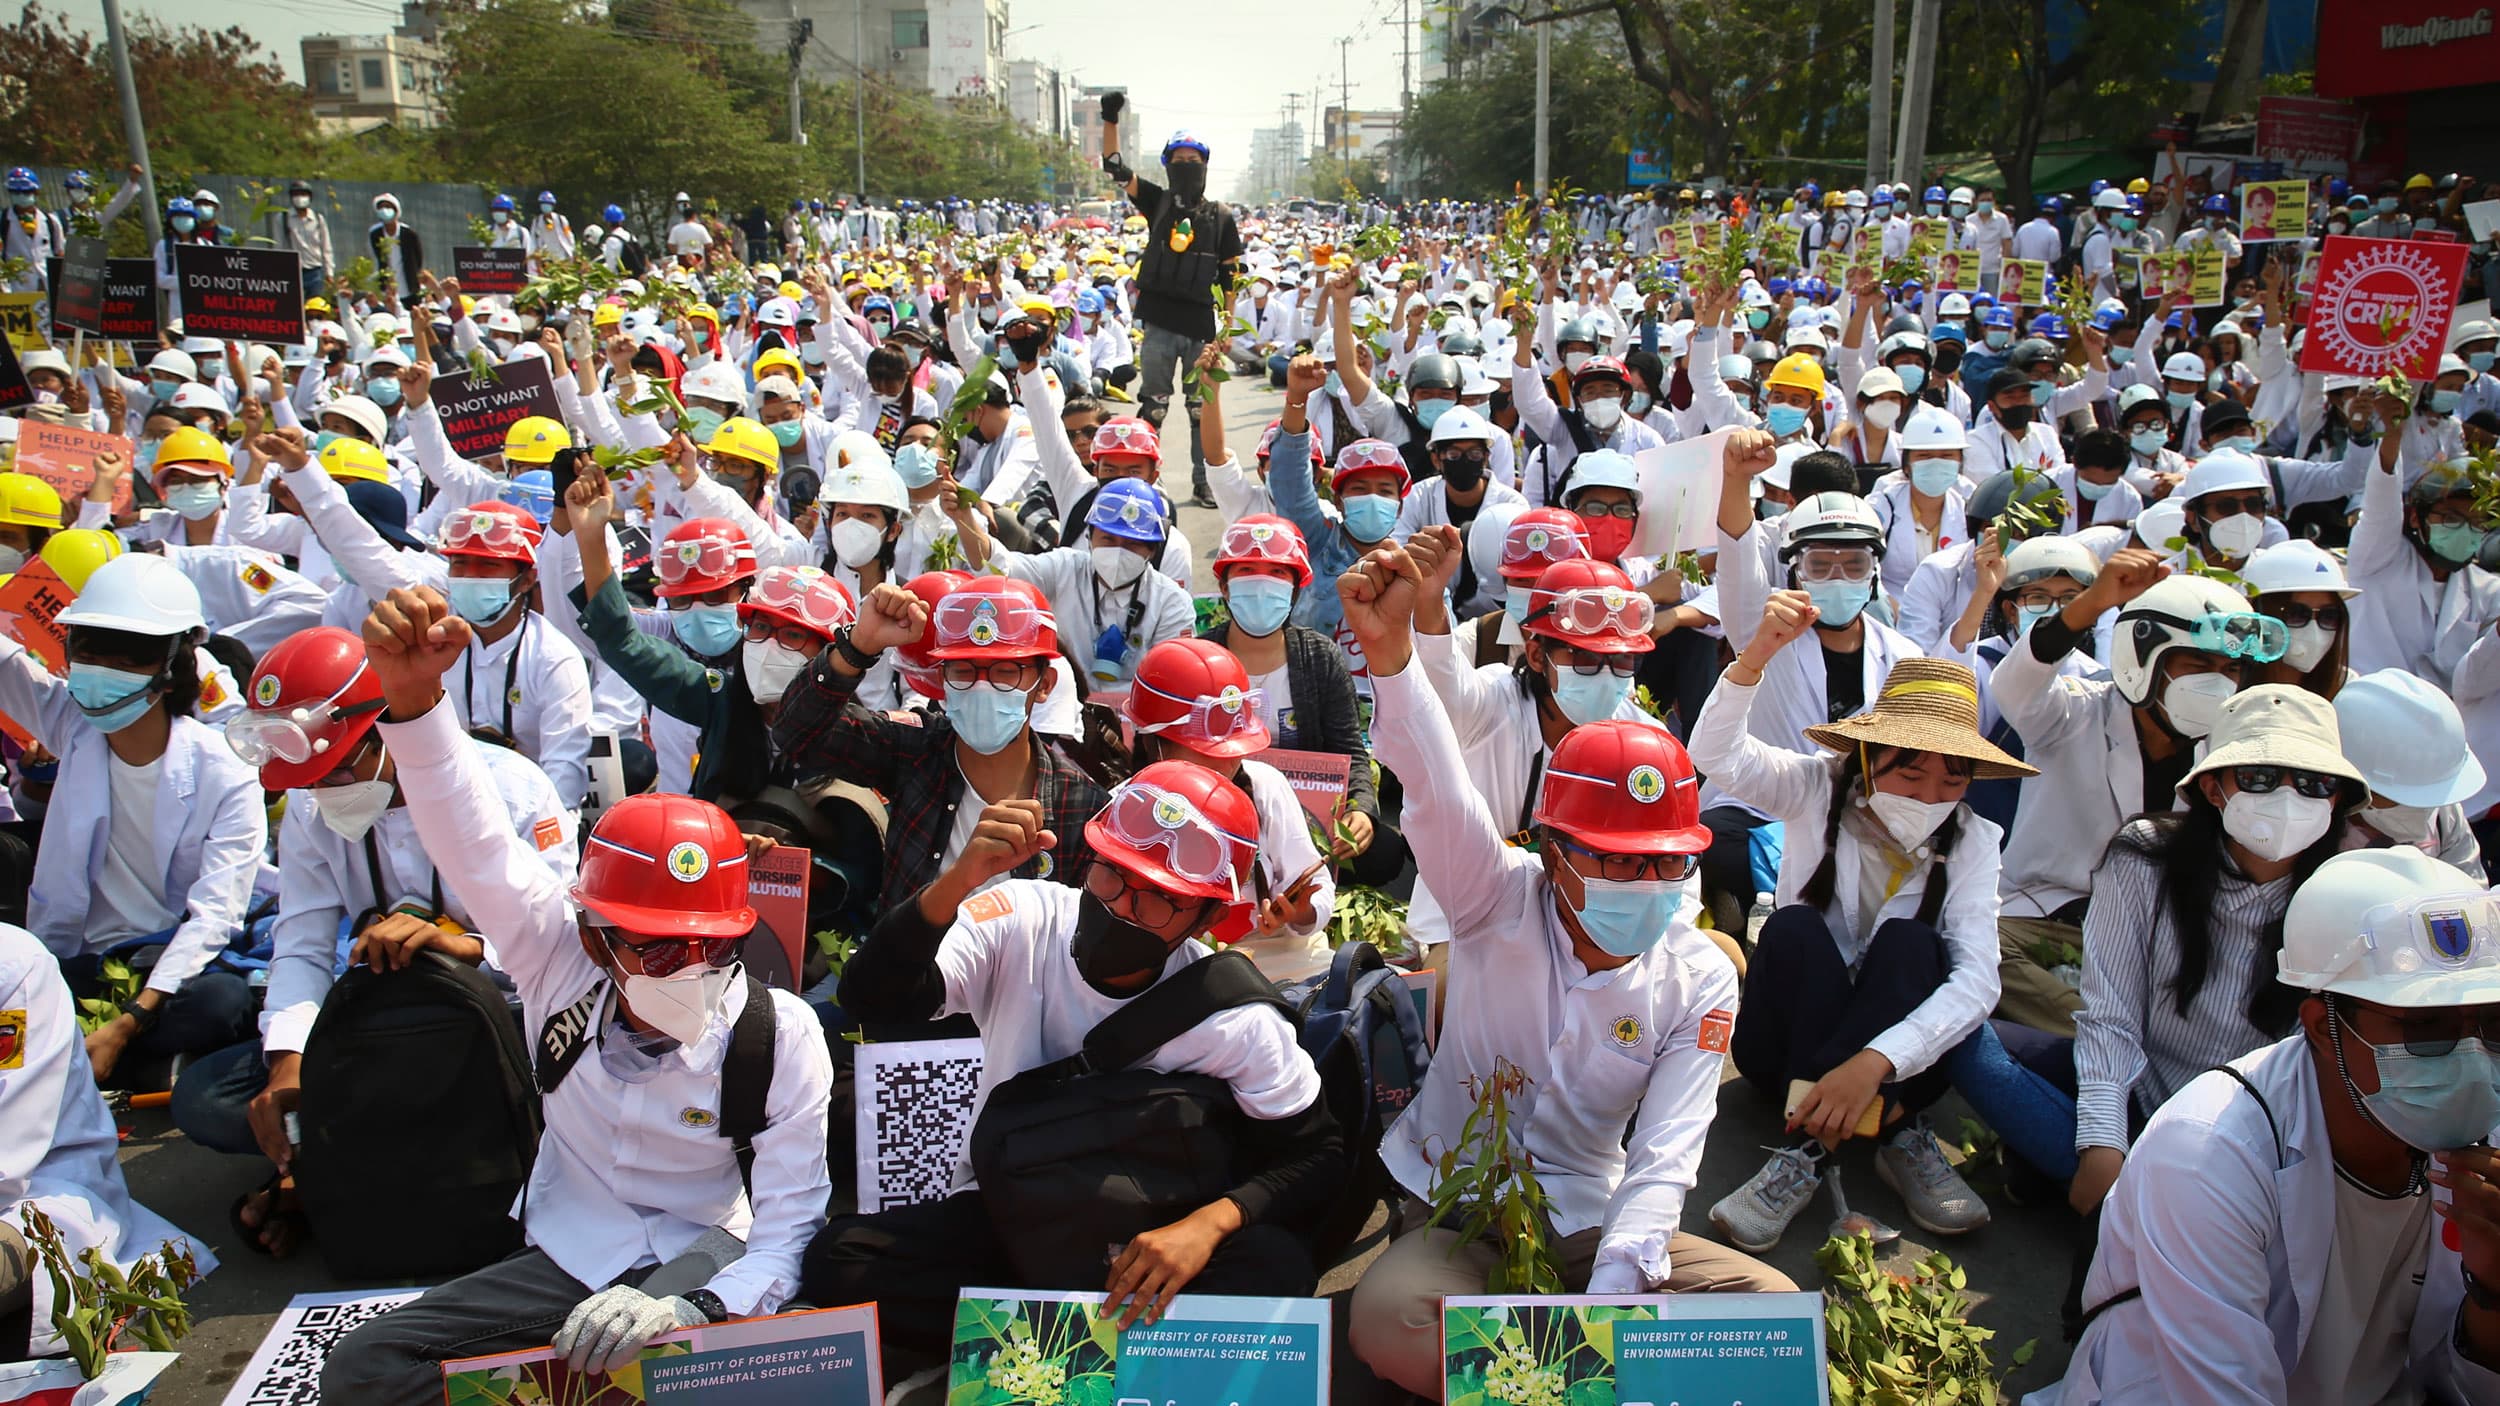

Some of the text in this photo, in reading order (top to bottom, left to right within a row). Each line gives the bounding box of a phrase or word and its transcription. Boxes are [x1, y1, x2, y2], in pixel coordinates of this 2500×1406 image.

[225, 257, 249, 271] WE
[108, 285, 147, 297] WANT
[189, 274, 289, 294] DO NOT WANT
[203, 294, 277, 313] MILITARY
[102, 319, 154, 334] NMENT
[185, 313, 299, 336] GOVERNMENT
[463, 378, 491, 392] WE
[454, 396, 489, 414] NOT
[491, 384, 540, 406] WANT
[447, 405, 531, 435] MILITARY
[39, 432, 114, 452] HELP US
[25, 601, 50, 625] SAVE
[1281, 769, 1345, 784] TATORSHIP
[1290, 779, 1344, 793] OLUTION
[749, 869, 802, 884] TORSHIP
[545, 987, 600, 1062] NIKE
[1127, 1330, 1293, 1345] UNIVERSITY OF FORESTRY AND
[1623, 1330, 1788, 1343] UNIVERSITY OF FORESTRY AND
[1126, 1346, 1307, 1362] ENVIRONMENTAL SCIENCE, YEZIN
[1623, 1346, 1803, 1359] ENVIRONMENTAL SCIENCE, YEZIN
[653, 1345, 837, 1380] UNIVERSITY OF FORESTRY AND
[655, 1357, 854, 1393] ENVIRONMENTAL SCIENCE, YEZIN
